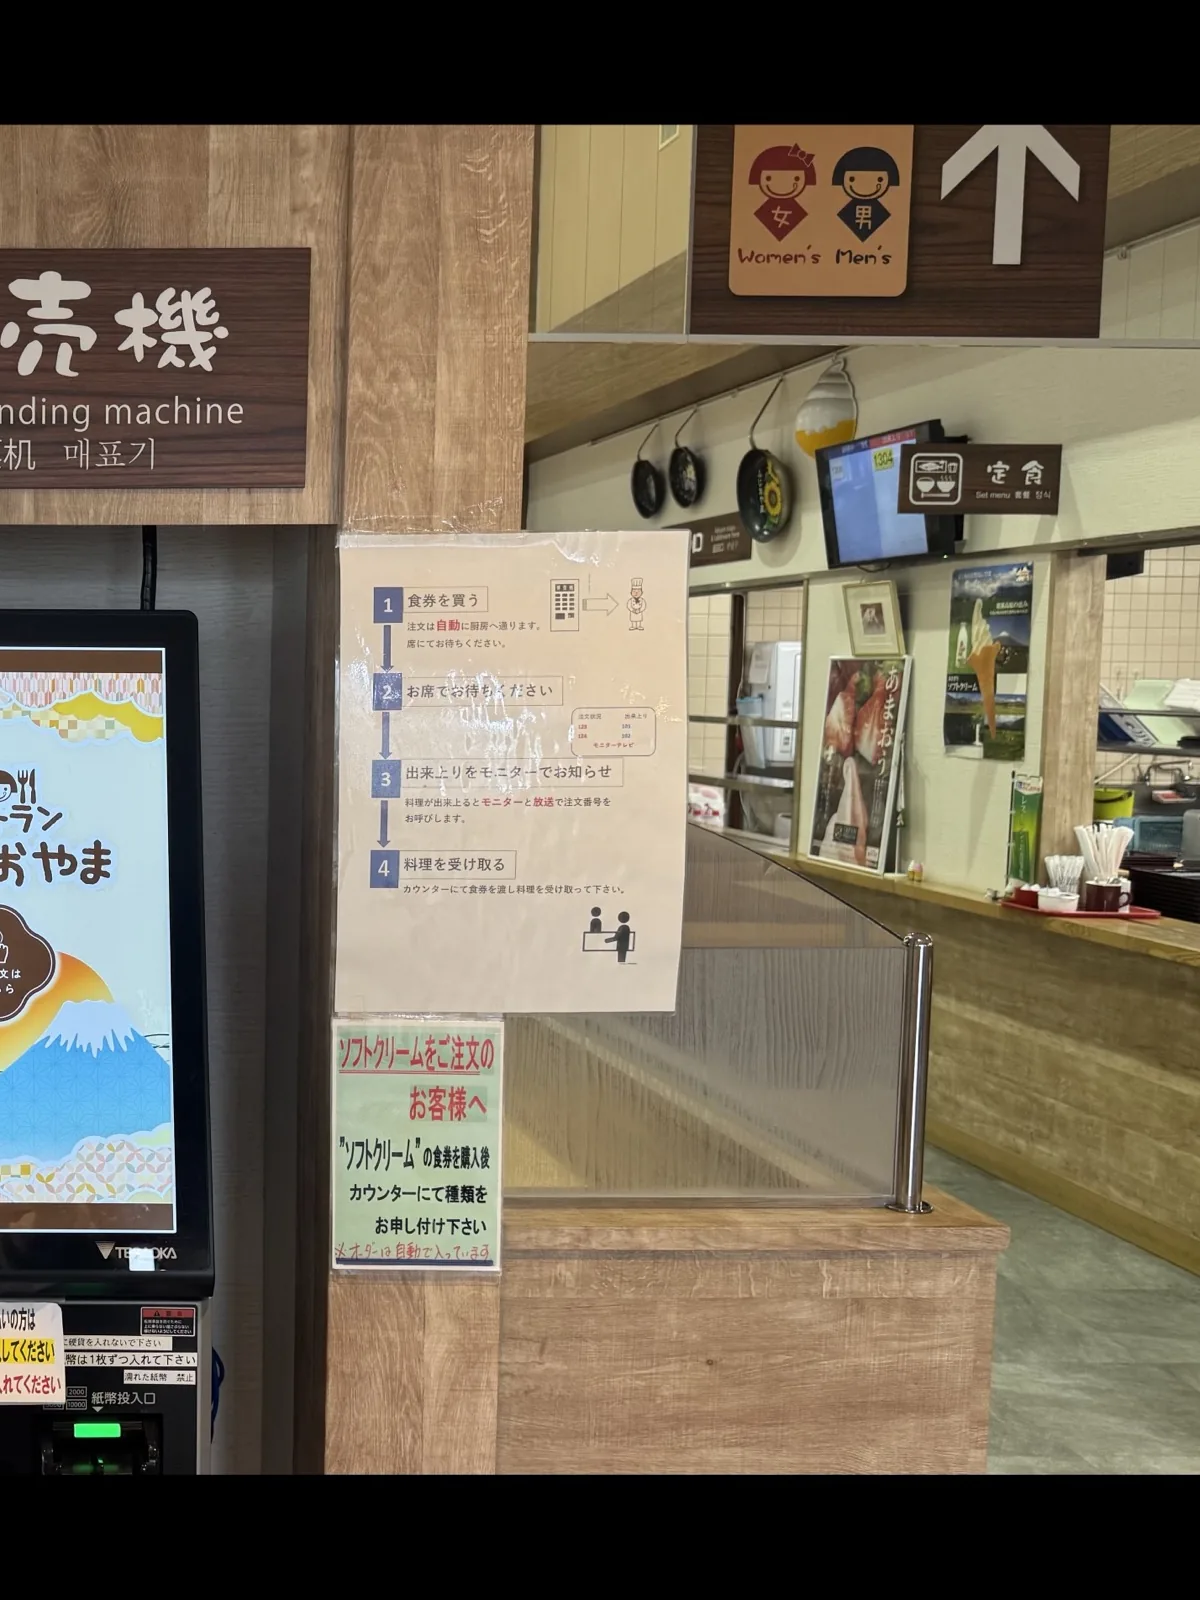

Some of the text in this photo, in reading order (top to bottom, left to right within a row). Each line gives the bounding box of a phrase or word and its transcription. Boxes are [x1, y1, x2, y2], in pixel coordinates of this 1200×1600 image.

[771, 205, 793, 228] 女
[855, 205, 873, 230] 男
[737, 244, 892, 265] Women's Men's
[103, 396, 245, 425] machine
[62, 436, 158, 472] 매표기
[986, 459, 1045, 486] 定食
[383, 593, 479, 613] 1 食券を買う
[406, 619, 542, 632] 注文は自動に厨房へ通ります。
[406, 638, 506, 649] 席にてお待ちください。
[382, 684, 393, 700] 2
[381, 772, 392, 787] 3
[404, 814, 466, 825] お呼びします。
[377, 857, 506, 877] 4 料理を受け取る
[339, 1034, 495, 1071] ソフトクリームをご注文の
[409, 1085, 488, 1122] お客様へ
[349, 1183, 488, 1204] カウンターにて種類を
[374, 1216, 487, 1236] お申し付け下さい
[115, 1247, 178, 1259] TEOKA
[64, 1354, 196, 1366] 幣は1枚ずつ入れて下さい
[91, 1392, 156, 1405] 紙幣投入口
